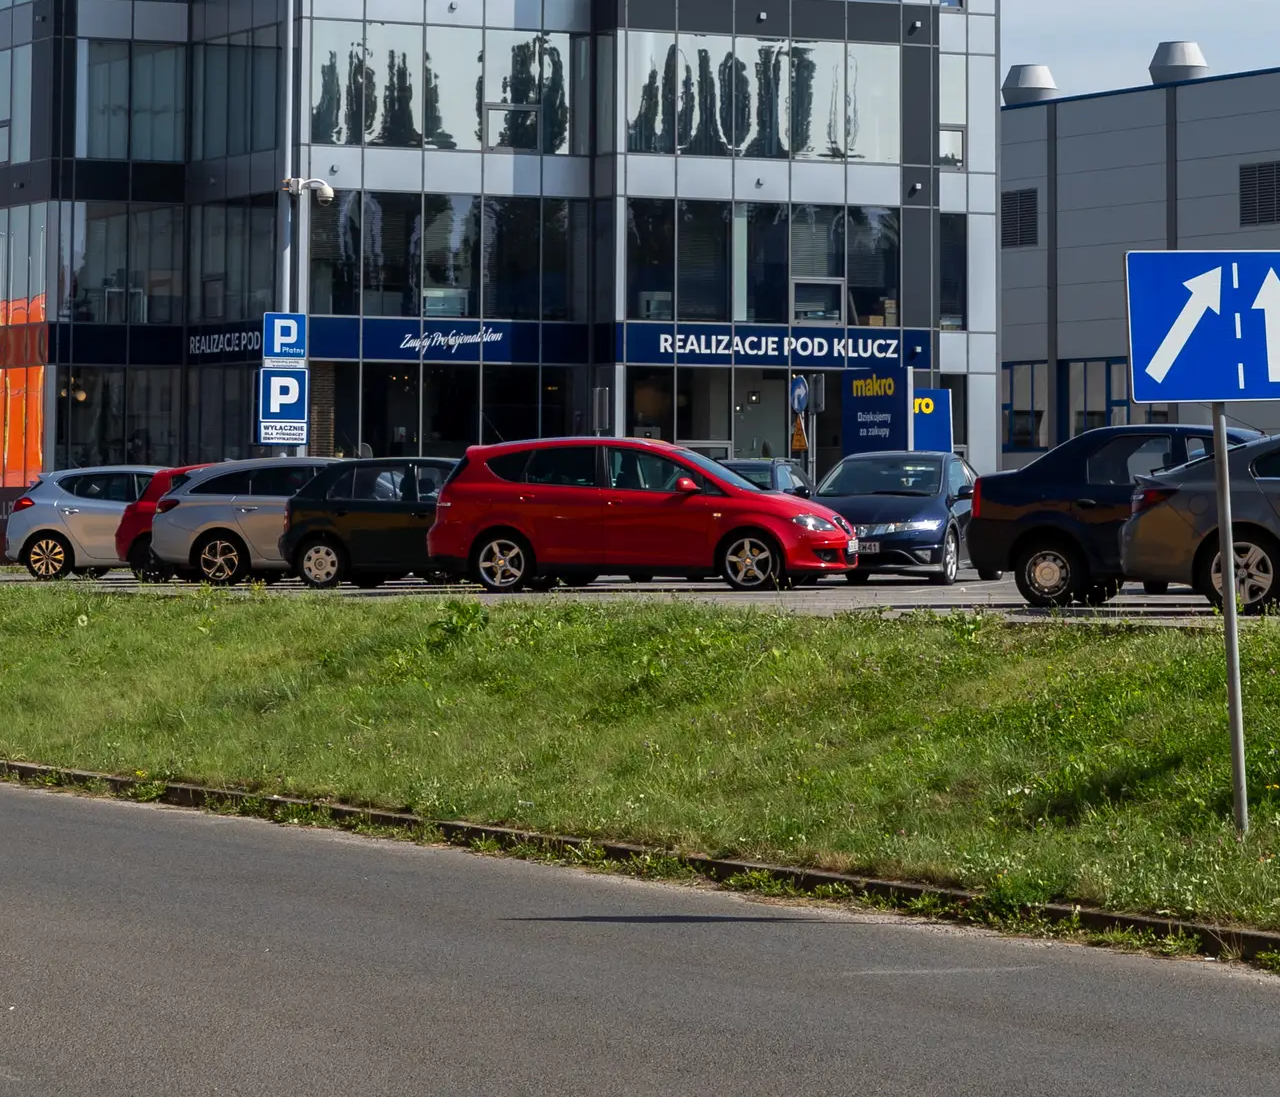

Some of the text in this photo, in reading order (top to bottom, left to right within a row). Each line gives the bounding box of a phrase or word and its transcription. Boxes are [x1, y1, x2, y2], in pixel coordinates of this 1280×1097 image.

[190, 331, 261, 354] REALIZACJE POD
[274, 319, 298, 353] P
[660, 334, 899, 359] REALIZACJE POD KLUCZ
[282, 346, 304, 355] Płatny
[270, 376, 299, 413] P
[852, 373, 895, 397] makro
[857, 411, 891, 424] Dziękujemy
[859, 427, 890, 438] za zakupy
